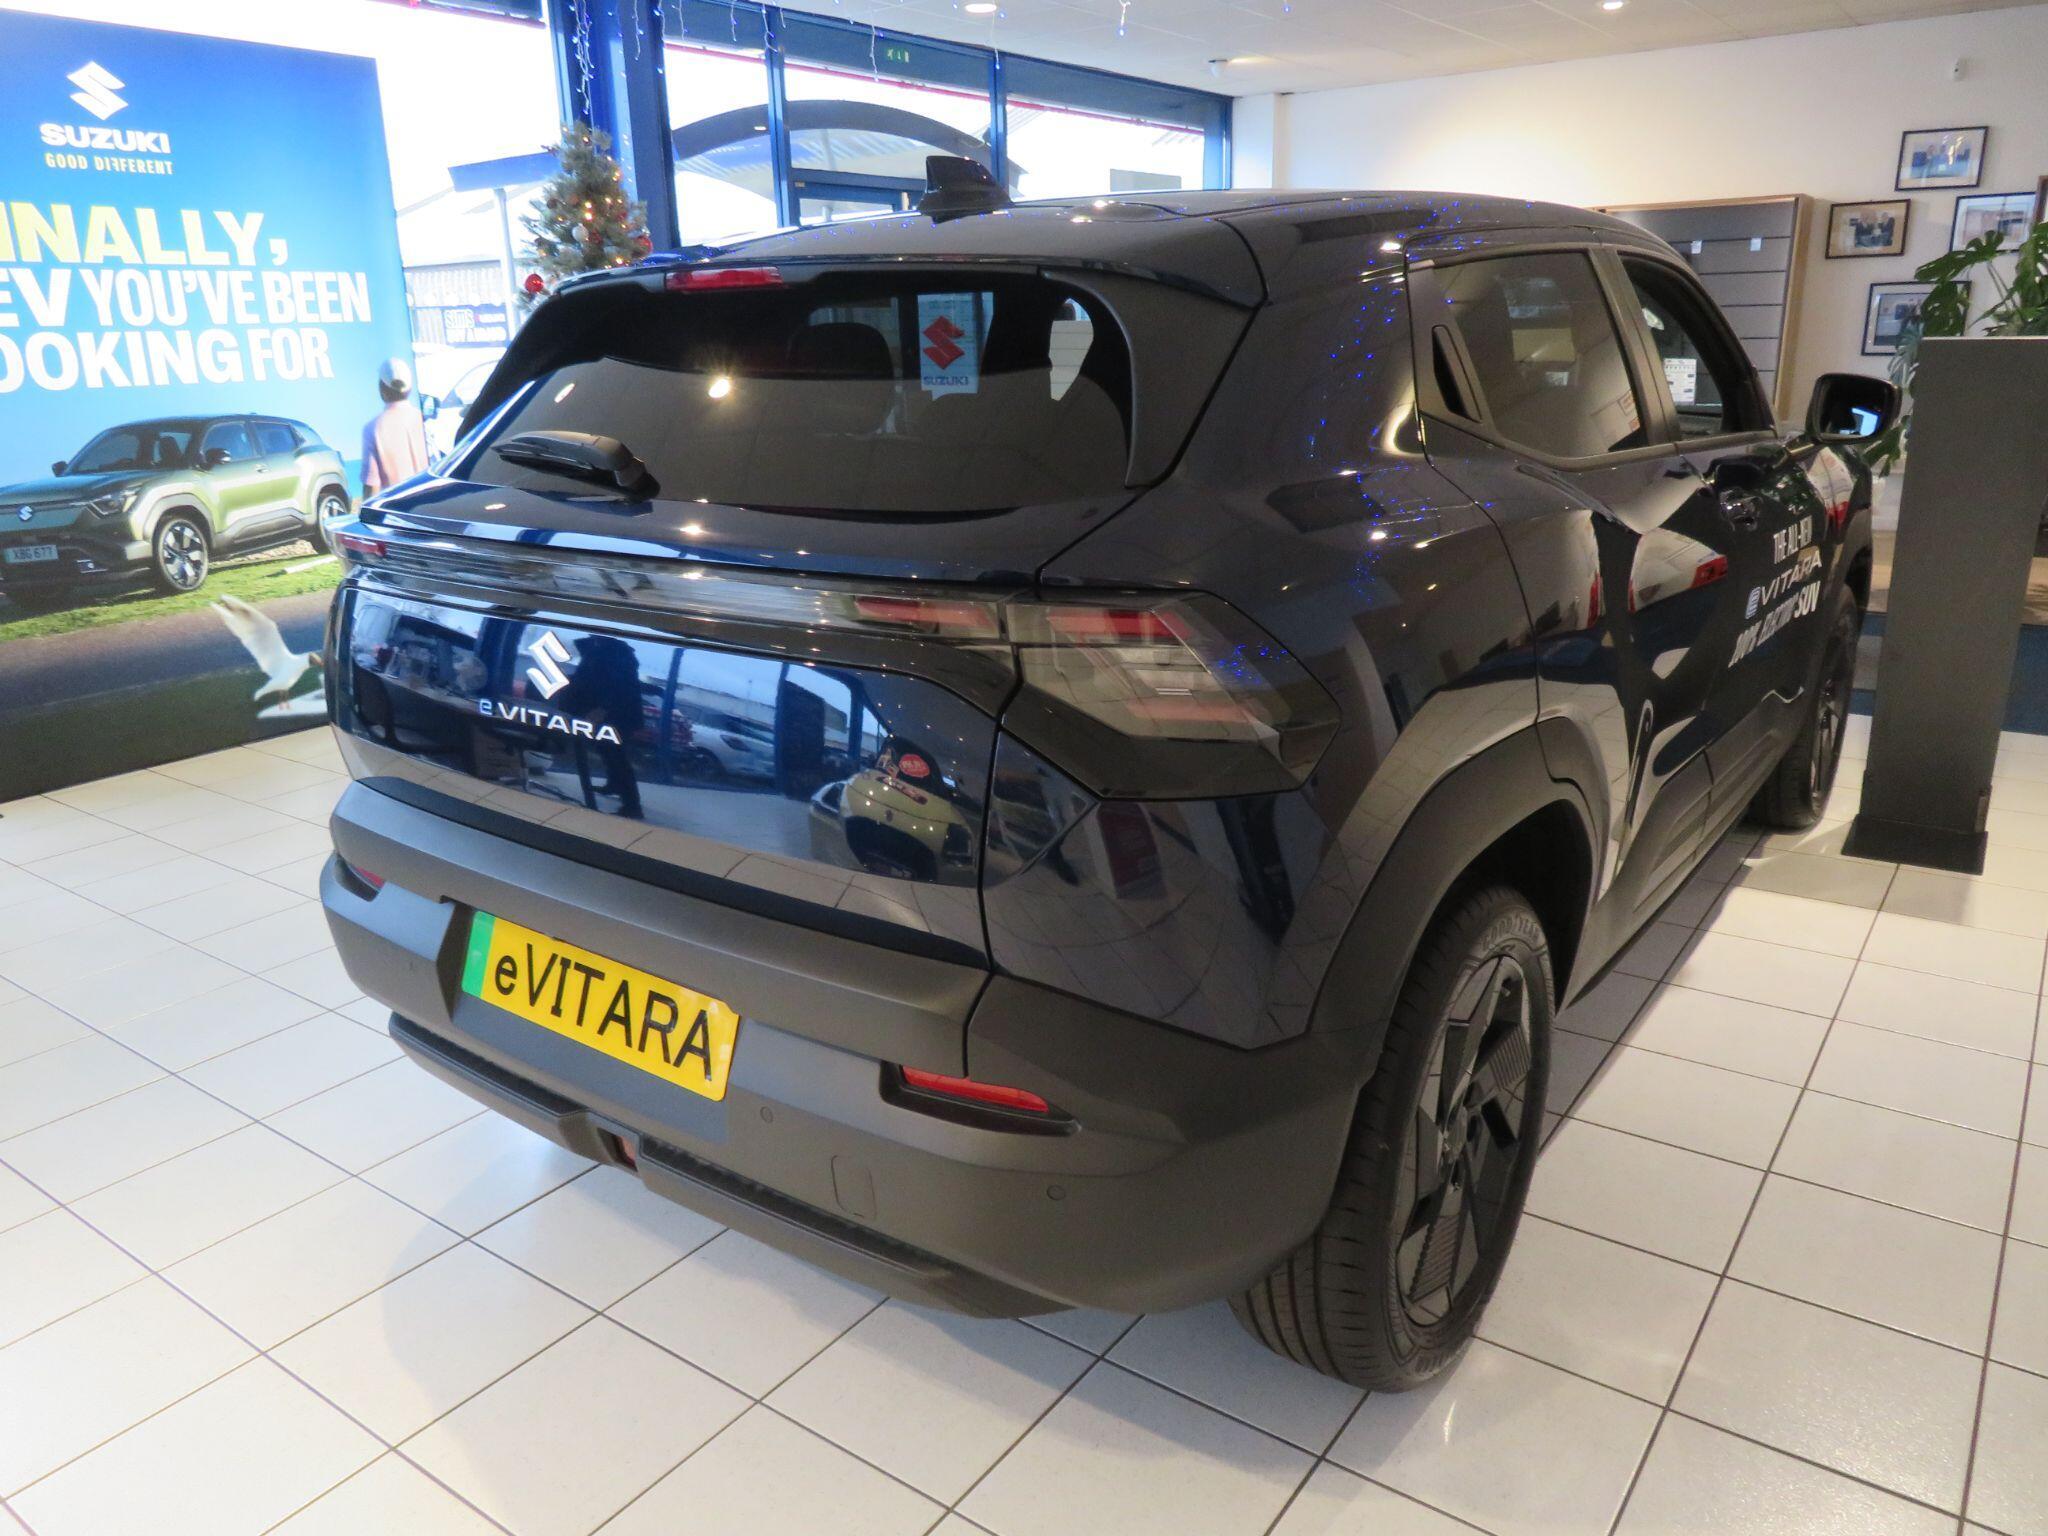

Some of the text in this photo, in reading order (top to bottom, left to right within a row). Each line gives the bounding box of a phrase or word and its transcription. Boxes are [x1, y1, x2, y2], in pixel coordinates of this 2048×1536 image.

[39, 122, 171, 154] SUZUKI
[44, 152, 88, 169] GOOD
[261, 270, 372, 324] BEEN
[247, 327, 335, 382] FOR
[923, 376, 969, 386] SUZUKI
[494, 942, 712, 1082] eVITARA
